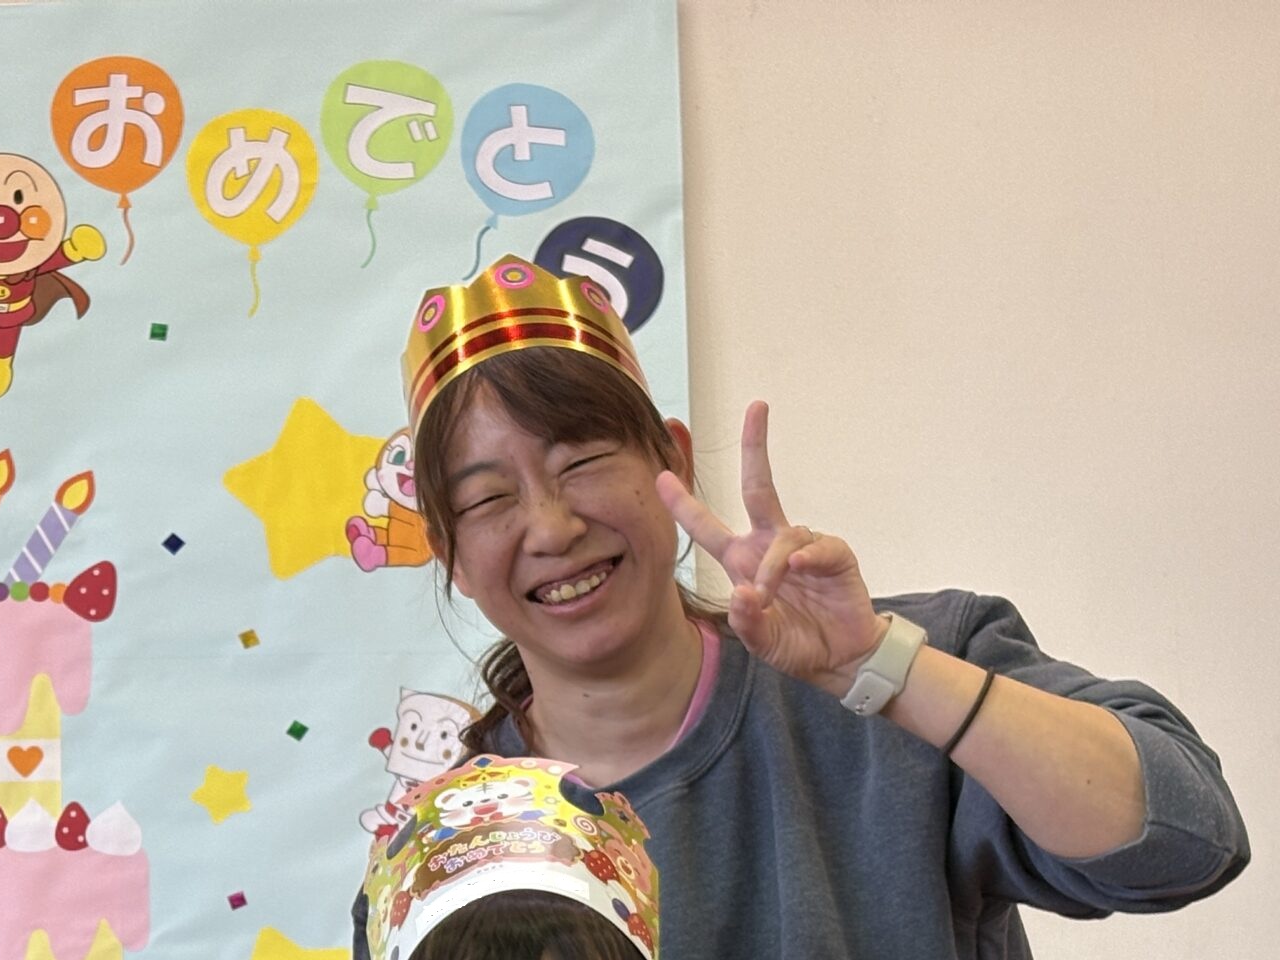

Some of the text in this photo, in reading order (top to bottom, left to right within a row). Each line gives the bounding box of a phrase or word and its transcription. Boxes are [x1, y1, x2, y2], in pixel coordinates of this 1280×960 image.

[428, 828, 560, 871] おたんじょうび
